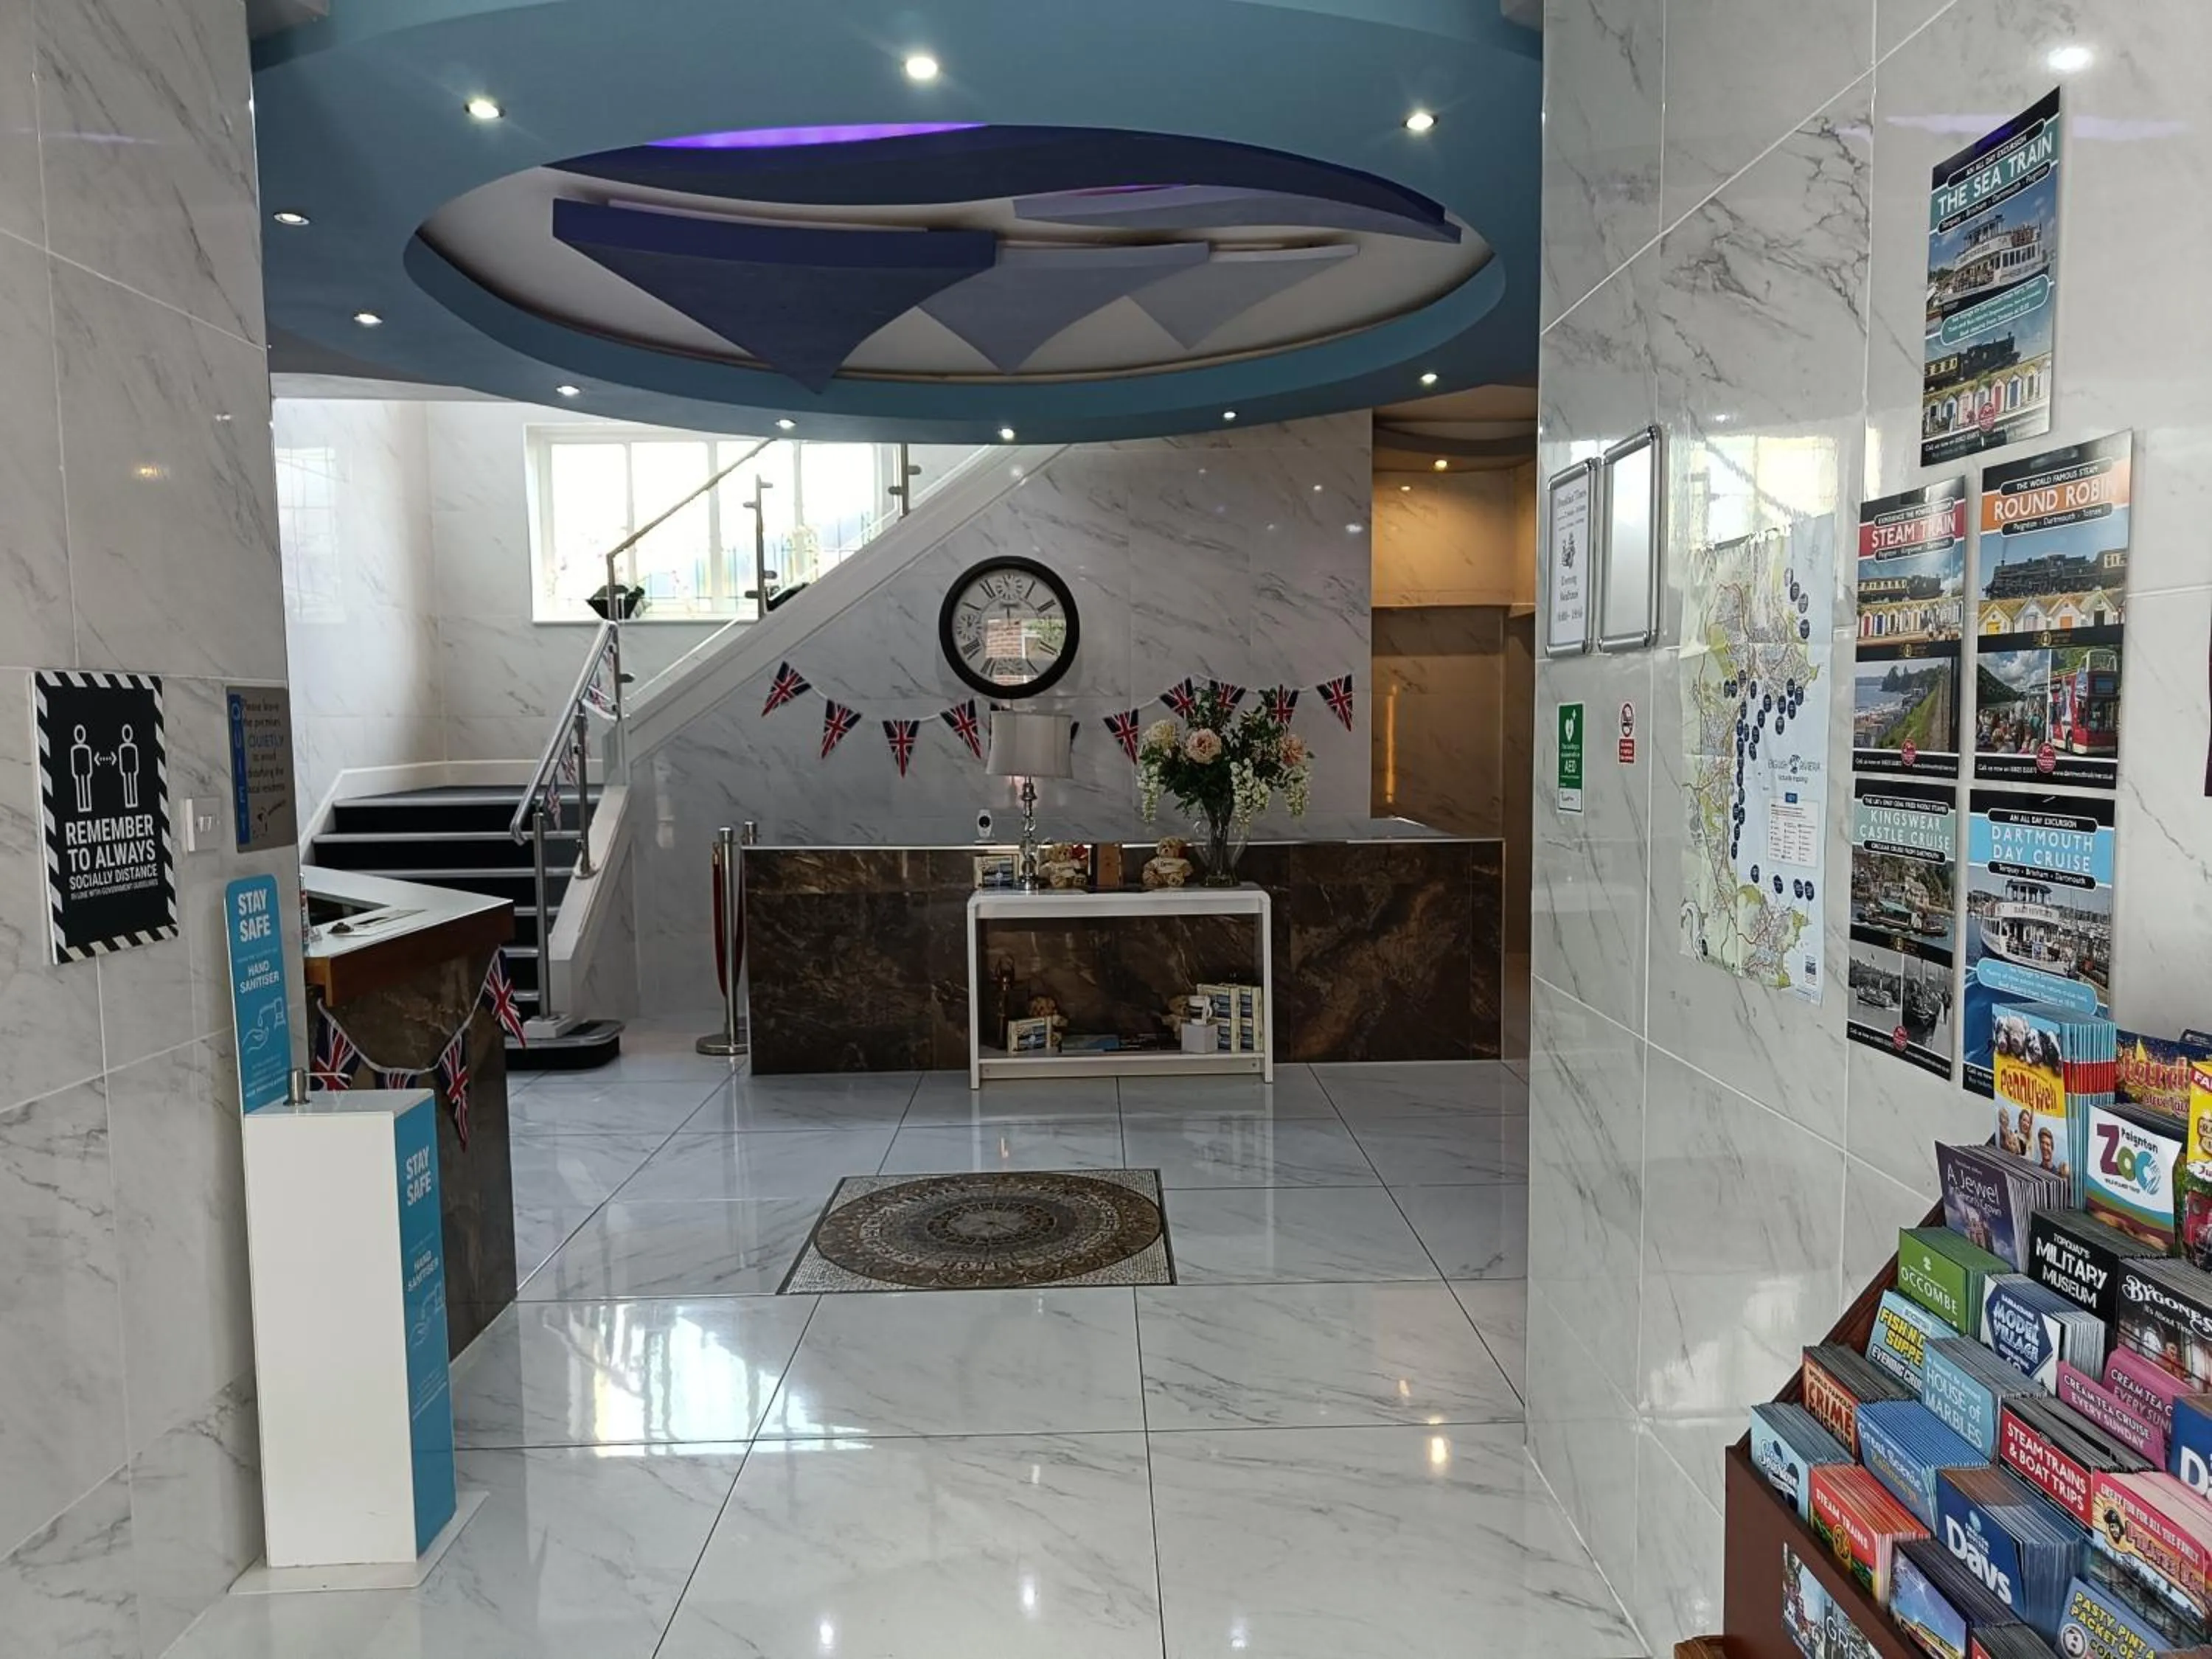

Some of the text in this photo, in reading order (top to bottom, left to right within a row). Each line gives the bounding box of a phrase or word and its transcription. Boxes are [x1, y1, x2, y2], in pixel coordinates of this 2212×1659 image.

[1938, 131, 2053, 216] THE SEA TRAIN
[2017, 466, 2098, 491] THE WORLD FAMOUS STEAM
[1994, 477, 2118, 521] ROUND ROBIN
[1871, 512, 1956, 549] STEAM TRAIN
[2043, 513, 2076, 526] Dartmouth
[65, 814, 154, 846] REMEMBER
[1859, 824, 1950, 851] CASTLE CRUISE
[1871, 809, 1941, 832] KINGSWEAR
[1992, 825, 2094, 853] DARTMOUTH
[2009, 814, 2077, 828] AN ALL DAY EXCURSION
[67, 838, 156, 872] TO ALWAYS
[1993, 844, 2091, 872] DAY CRUISE
[69, 862, 158, 891] SOCIALLY DISTANCE
[1998, 863, 2086, 885] Torquay Brixham Dartmouth
[237, 888, 268, 916] STAY
[240, 914, 271, 942] SAFE
[240, 970, 279, 994] SANITISER
[248, 960, 270, 977] HAND
[2194, 1071, 2212, 1093] FA
[2121, 1127, 2158, 1154] Paignton
[406, 1144, 429, 1180] STAY
[406, 1170, 431, 1207] SAFE
[1947, 1163, 1958, 1186] A
[1960, 1169, 2000, 1206] Jewel
[2036, 1237, 2108, 1290] MILITARY
[2053, 1232, 2091, 1259] TORQUAY'S
[1901, 1266, 1958, 1316] OCCOMBE
[2042, 1264, 2096, 1310] MUSEUM
[1879, 1306, 1907, 1336] FISH
[1993, 1300, 2039, 1347] MODEL
[2121, 1274, 2212, 1341] BYGONES
[1885, 1328, 1923, 1368] SUPPE
[1993, 1318, 2039, 1364] VILLAGE
[1872, 1345, 1905, 1377] EVENING
[1807, 1380, 1853, 1437] CRIME
[1926, 1365, 1966, 1412] HOUSE
[1969, 1404, 1982, 1423] of
[2064, 1374, 2095, 1402] CREAM
[2096, 1396, 2115, 1416] TEA
[2115, 1408, 2151, 1440] CRUISE
[2111, 1368, 2143, 1397] CREAM
[2144, 1389, 2164, 1412] TEA
[1925, 1388, 1983, 1449] MARBLES
[2071, 1391, 2145, 1449] EVERY SUNDAY
[2113, 1385, 2147, 1415] EVERY
[2146, 1409, 2171, 1435] SUN
[2007, 1422, 2087, 1495] STEAM TRAINS
[2009, 1441, 2084, 1512] & BOAT TRIPS
[1815, 1487, 1868, 1551] STEAM TRAINS
[2070, 1603, 2118, 1647] PACKET
[2074, 1590, 2147, 1652] PASTY PINT
